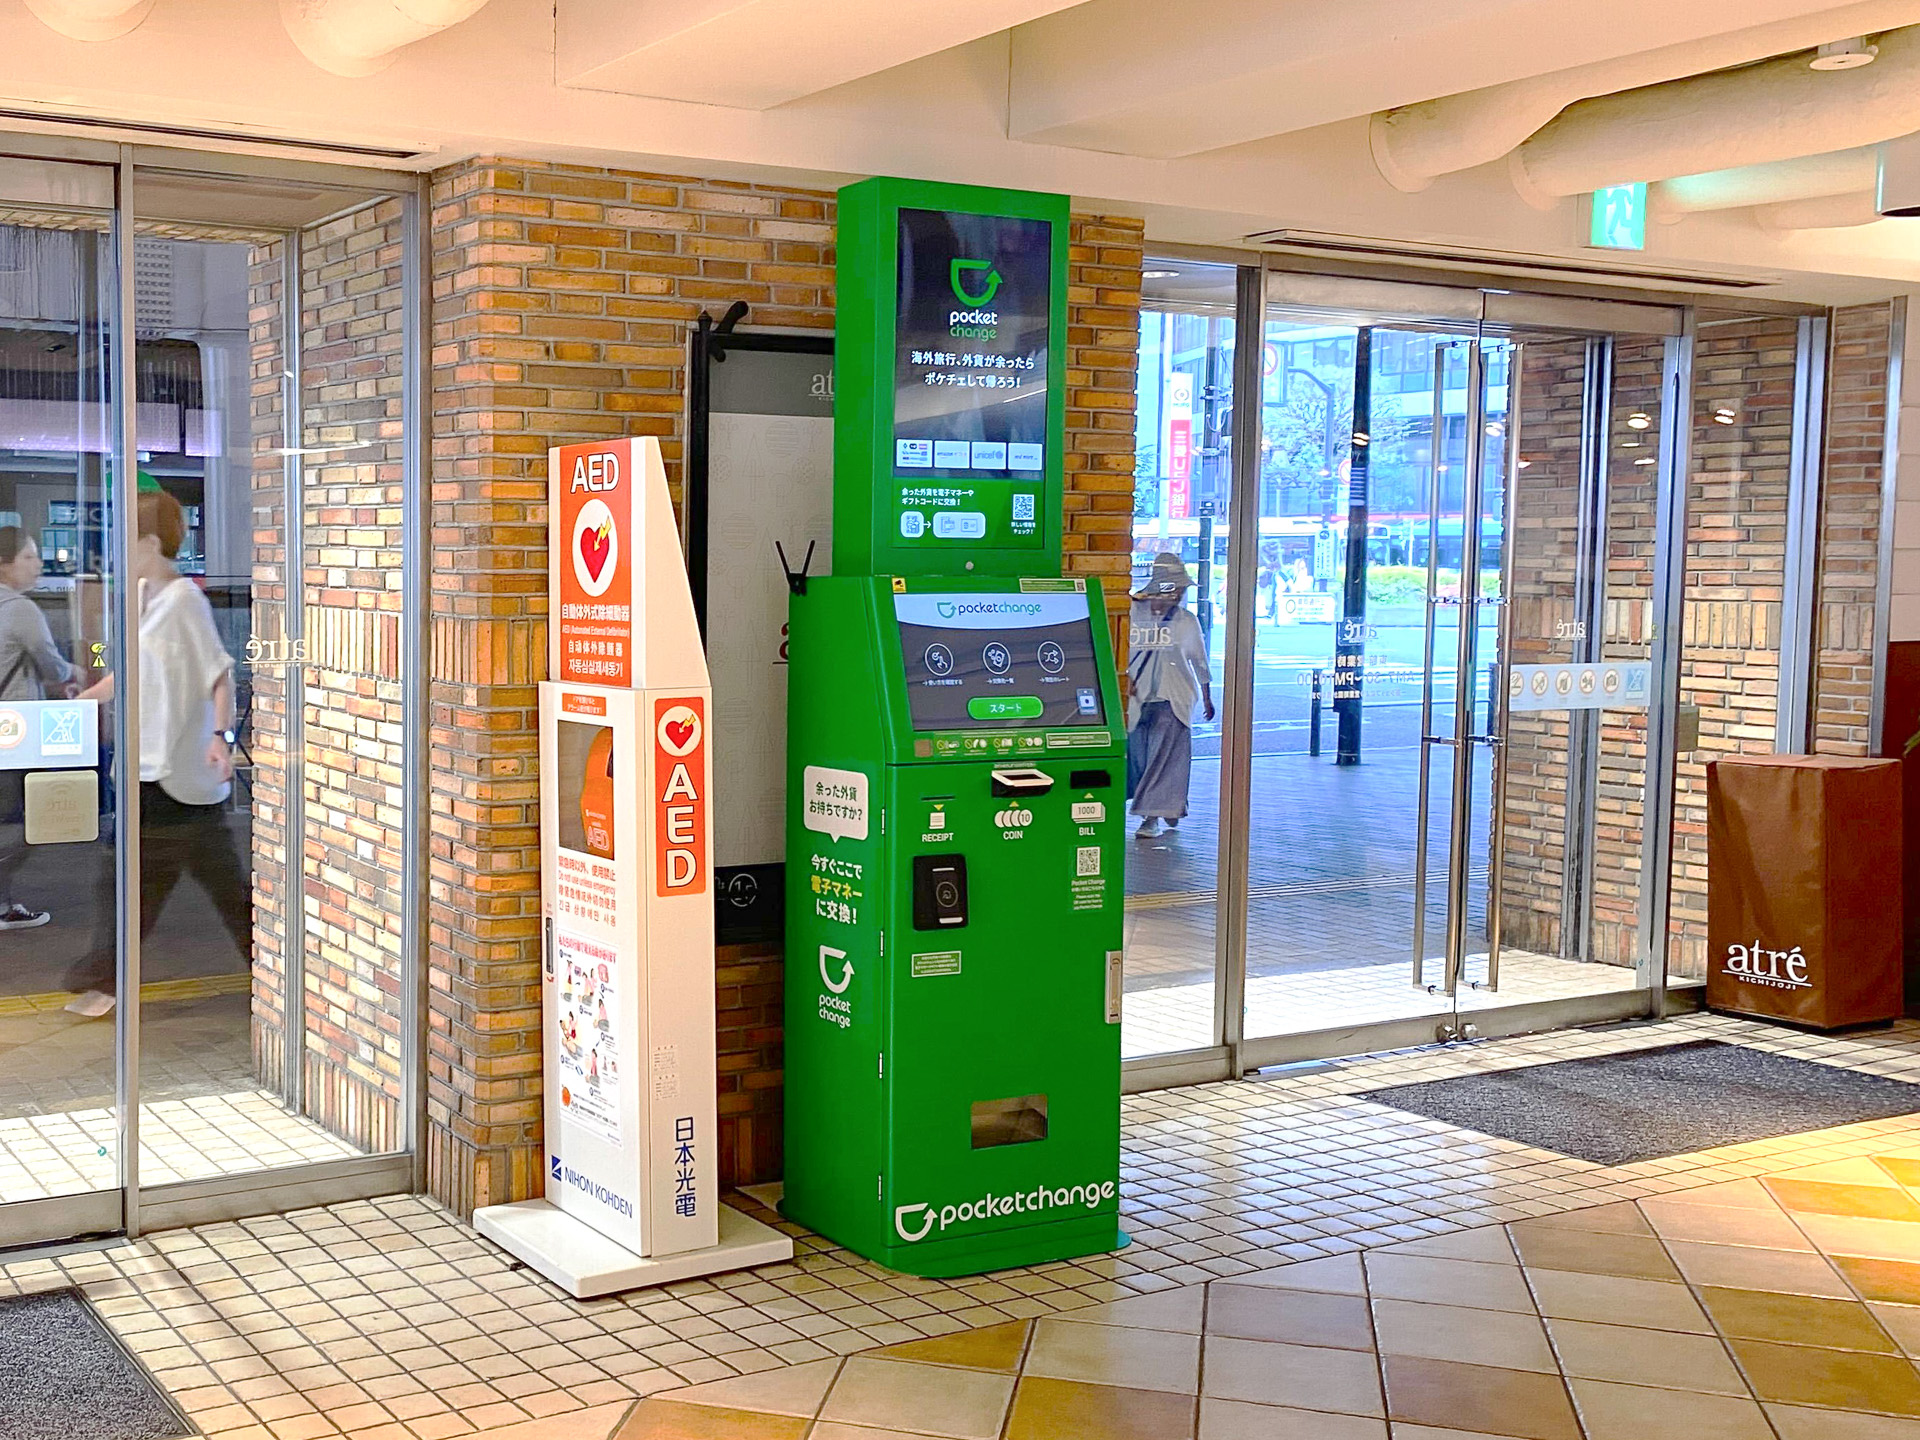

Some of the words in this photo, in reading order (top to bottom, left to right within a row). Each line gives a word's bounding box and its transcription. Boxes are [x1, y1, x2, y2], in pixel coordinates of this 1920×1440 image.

[950, 309, 998, 326] pocket
[950, 324, 998, 342] change
[911, 350, 1035, 370] 海外旅行、外貨が余ったら
[974, 450, 996, 460] unicef
[570, 452, 620, 494] AED
[958, 600, 1042, 616] pocketchange
[989, 703, 1022, 713] スタート
[815, 781, 858, 802] 余った外貨
[809, 799, 863, 821] お持ちですか?
[1020, 813, 1031, 823] 10
[1077, 805, 1096, 815] 1000
[661, 762, 698, 889] AED
[1003, 830, 1024, 840] COIN
[1078, 826, 1096, 836] BILL
[587, 825, 610, 851] AED
[921, 832, 954, 842] RECEIPT
[811, 853, 862, 880] 今すぐここで
[810, 874, 863, 900] 電子マネー
[816, 899, 857, 925] に交換!
[1727, 939, 1809, 983] atré
[1739, 976, 1797, 991] KICHIJOJI
[818, 994, 851, 1014] pocket
[818, 1006, 851, 1029] change
[674, 1116, 697, 1218] 日本光電
[564, 1166, 594, 1196] NIHON
[595, 1183, 633, 1219] KOHDEN
[939, 1179, 1115, 1231] pocketchange
